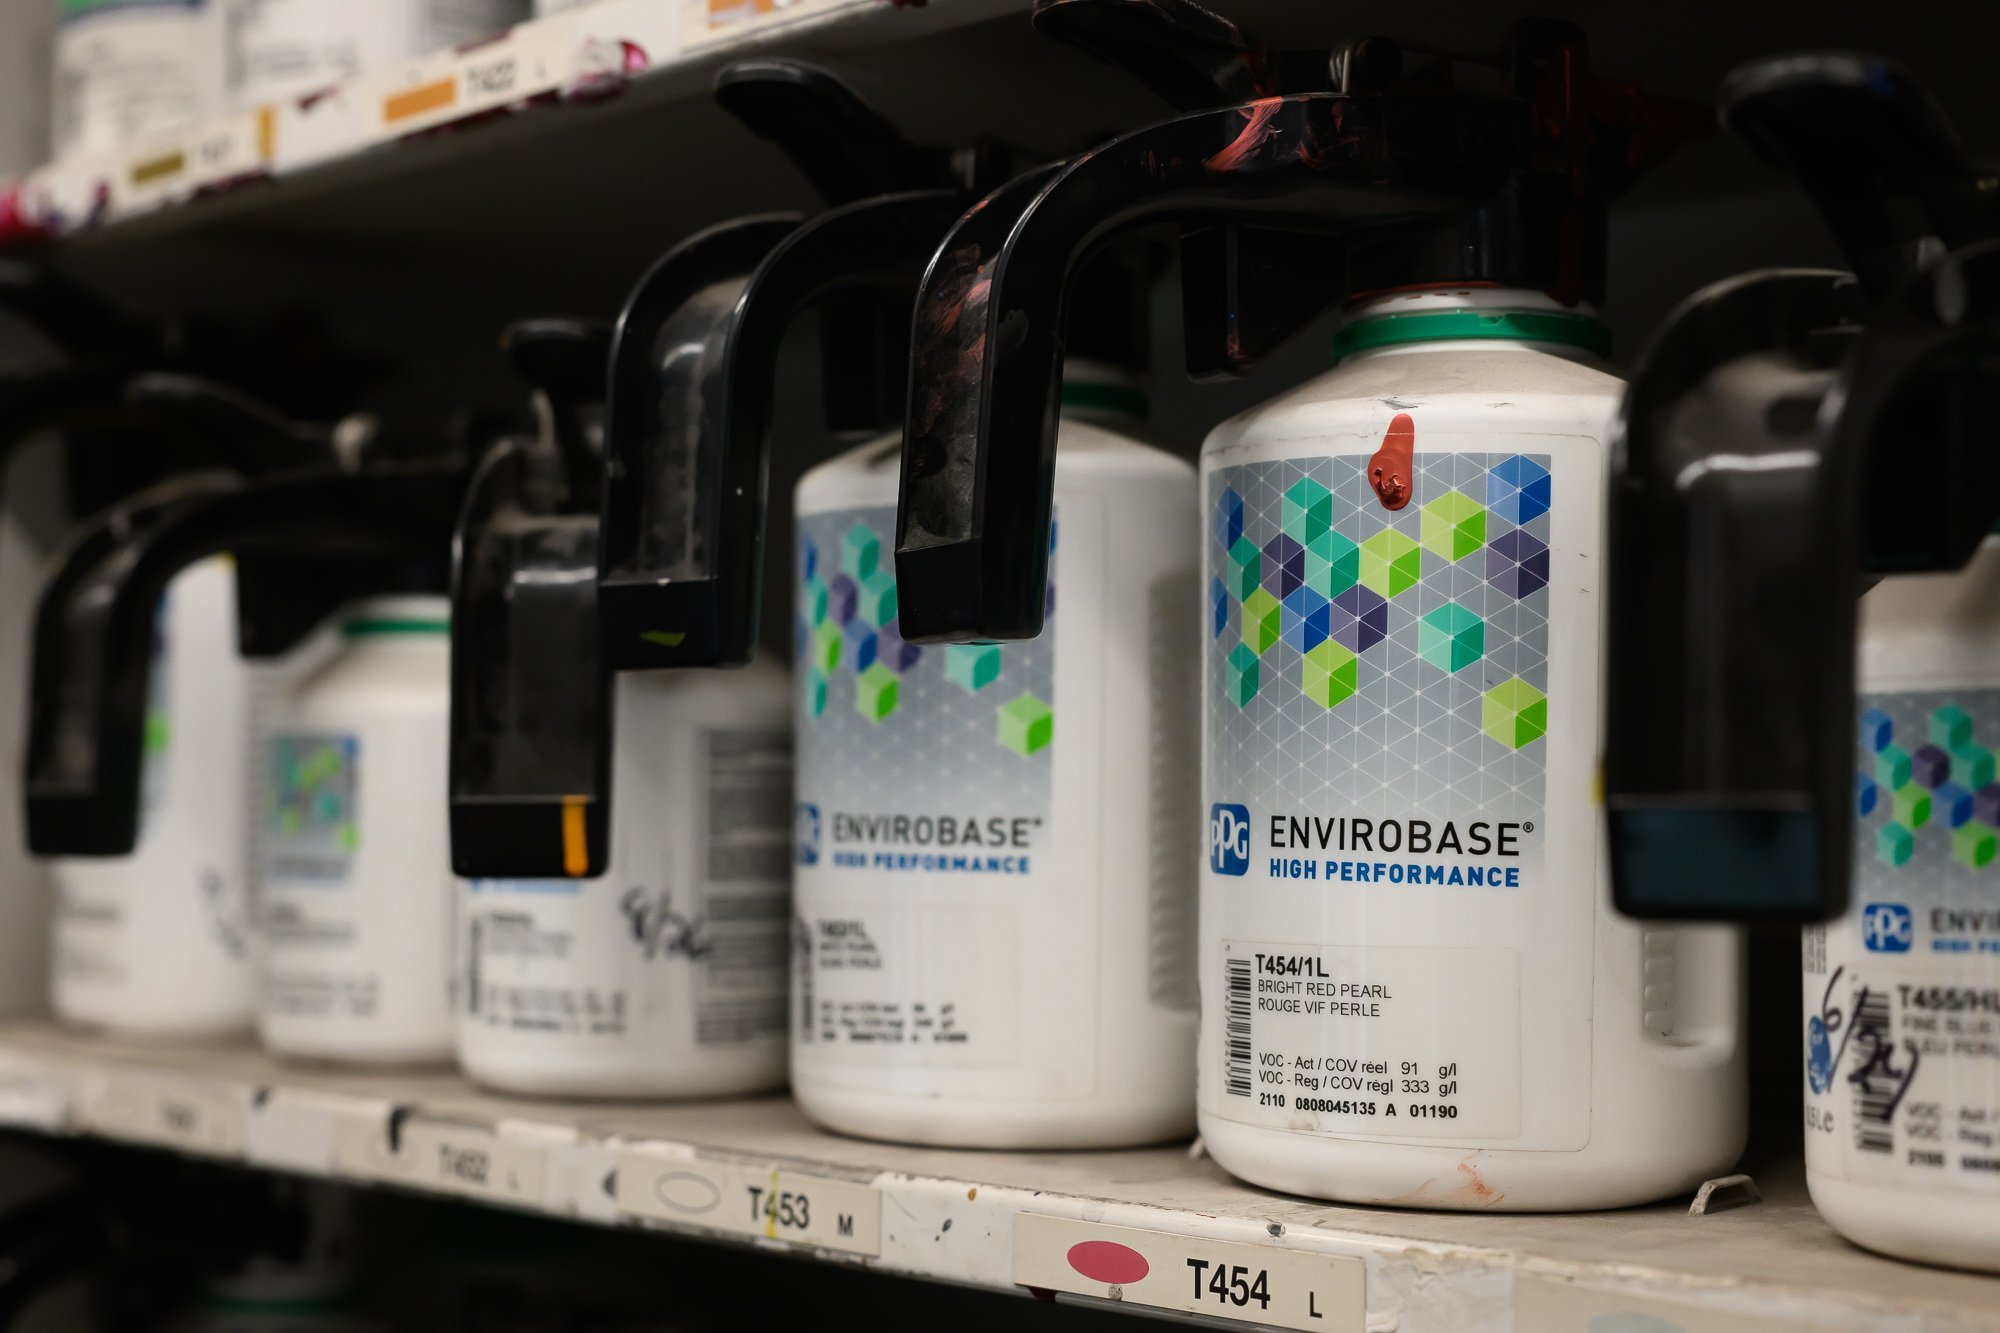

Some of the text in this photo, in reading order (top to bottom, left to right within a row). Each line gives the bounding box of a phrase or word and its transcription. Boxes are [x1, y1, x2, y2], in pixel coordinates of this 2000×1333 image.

[874, 854, 1031, 875] PERFORMANCE
[1270, 857, 1520, 888] HIGH PERFORMANCE
[1930, 907, 2000, 933] ENVI
[1255, 953, 1330, 978] T454/1L
[1258, 979, 1392, 999] BRIGHT RED PEARL
[1258, 998, 1380, 1017] ROUGE VIF PERLE
[1258, 1052, 1284, 1067] VOC
[1294, 1056, 1314, 1070] Act
[1317, 1057, 1322, 1071] /
[1325, 1058, 1358, 1072] COV
[1361, 1060, 1388, 1074] réel
[1401, 1061, 1419, 1076] 91
[1438, 1063, 1457, 1079] g/l
[1258, 1070, 1284, 1084] VOC
[1294, 1073, 1319, 1091] Reg
[1322, 1075, 1327, 1089] /
[1330, 1076, 1363, 1091] COV
[1401, 1080, 1430, 1093] 333
[1438, 1081, 1457, 1097] g/l
[1259, 1092, 1458, 1119] 2110 0808045135 A 01190
[747, 1184, 854, 1237] T453 M
[1186, 1257, 1323, 1319] T454 L
